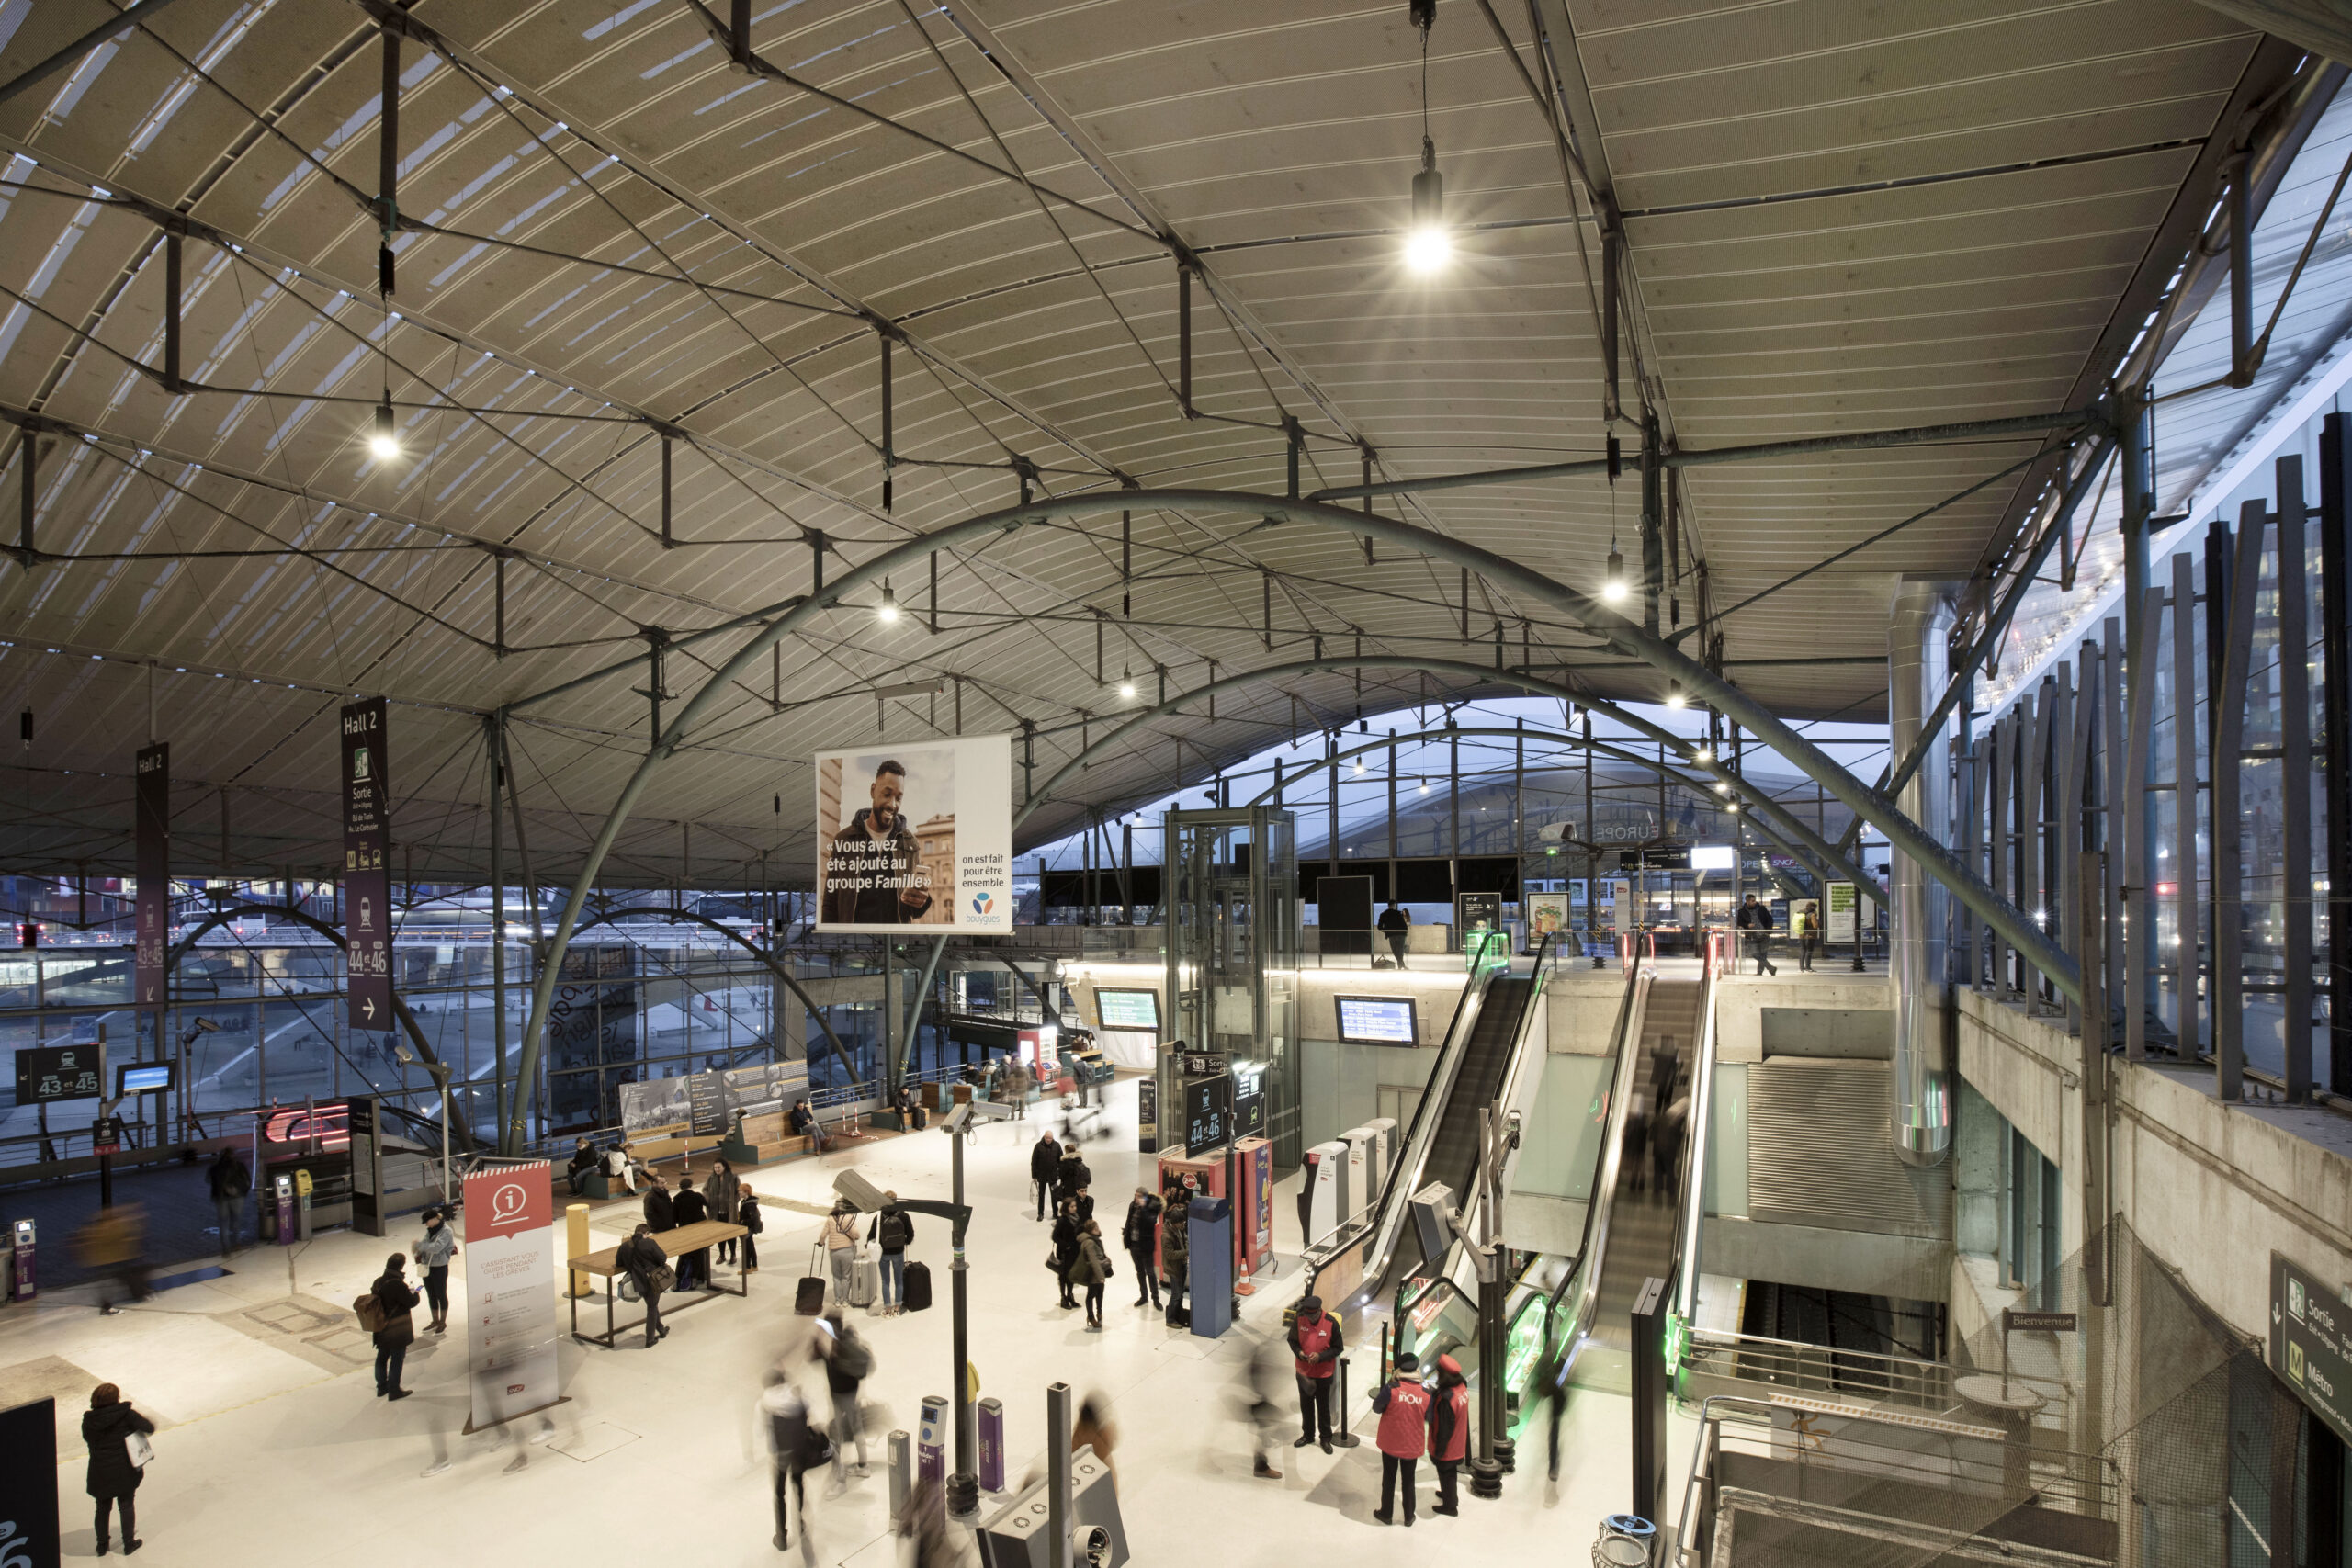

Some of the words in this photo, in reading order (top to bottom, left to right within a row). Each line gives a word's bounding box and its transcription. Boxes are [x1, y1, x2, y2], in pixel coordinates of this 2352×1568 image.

[345, 714, 367, 735] Hall
[370, 711, 377, 729] 2
[139, 757, 154, 773] Hall
[156, 753, 162, 769] 2
[353, 786, 371, 800] Sortie
[835, 840, 866, 852] Vous
[867, 840, 898, 852] avez
[827, 857, 846, 872] été
[848, 856, 888, 871] ajouté
[890, 858, 907, 871] au
[989, 853, 1003, 863] fait
[1772, 859, 1794, 868] SNCF
[964, 868, 983, 878] pour
[985, 866, 1002, 876] être
[827, 876, 873, 893] groupe
[962, 878, 1004, 887] ensemble
[966, 913, 1001, 926] bouygues
[138, 947, 147, 964] 43
[153, 946, 163, 964] 45
[349, 950, 364, 971] 44
[364, 953, 370, 963] et
[371, 950, 386, 973] 46
[39, 1080, 62, 1094] 43
[75, 1077, 98, 1090] 45
[1191, 1125, 1203, 1143] 44
[1208, 1120, 1220, 1137] 46
[481, 1255, 520, 1269] L'ASSISTANT
[522, 1250, 539, 1259] VOUS
[483, 1265, 505, 1275] GUIDE
[506, 1258, 537, 1270] PENDANT
[492, 1270, 504, 1280] LES
[2013, 1315, 2073, 1326] Bienvenue
[2309, 1298, 2335, 1332] Sortie
[2308, 1322, 2317, 1337] Exit
[2308, 1361, 2334, 1397] Métro
